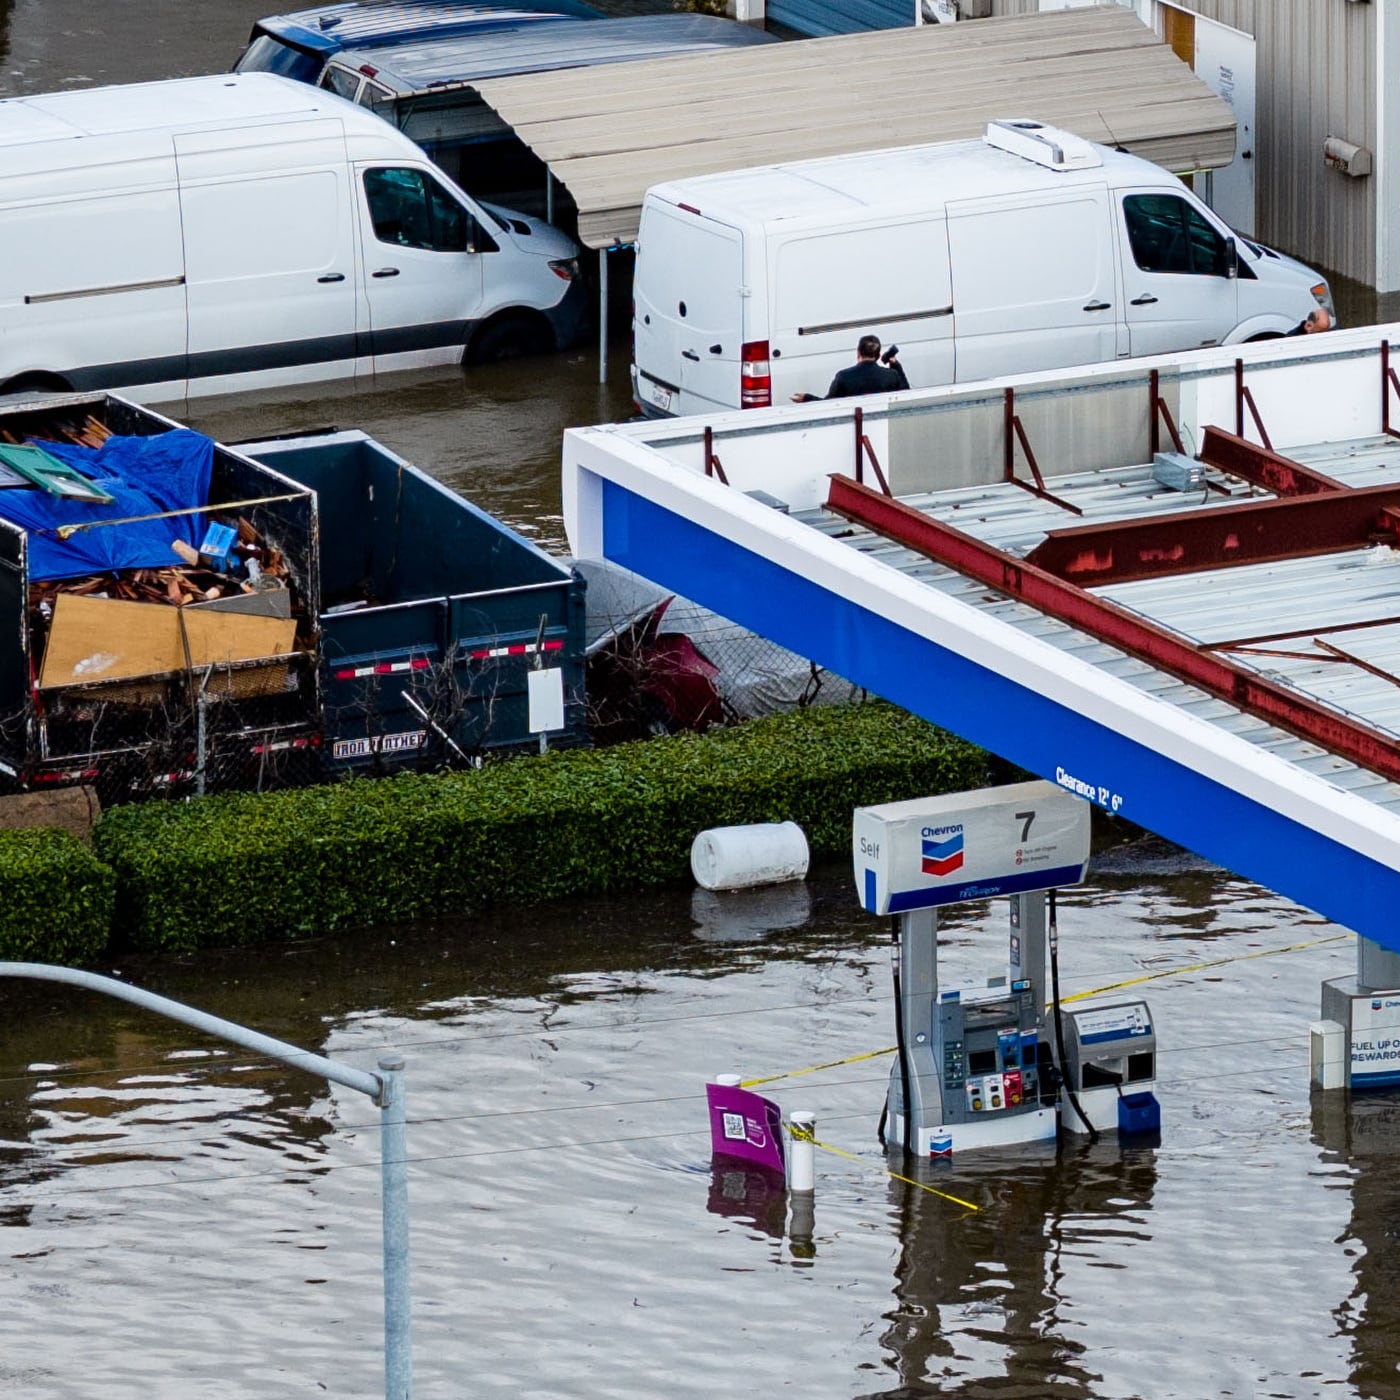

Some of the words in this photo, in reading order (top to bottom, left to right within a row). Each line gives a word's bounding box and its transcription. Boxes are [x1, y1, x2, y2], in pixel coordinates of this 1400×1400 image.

[368, 733, 427, 752] PNTHER
[1056, 766, 1096, 800] Clearance
[1098, 786, 1110, 806] 12'
[921, 823, 964, 838] Chevron
[1015, 811, 1036, 842] 7
[860, 838, 880, 860] Self
[1350, 1042, 1375, 1051] FUEL
[1377, 1040, 1391, 1049] UP
